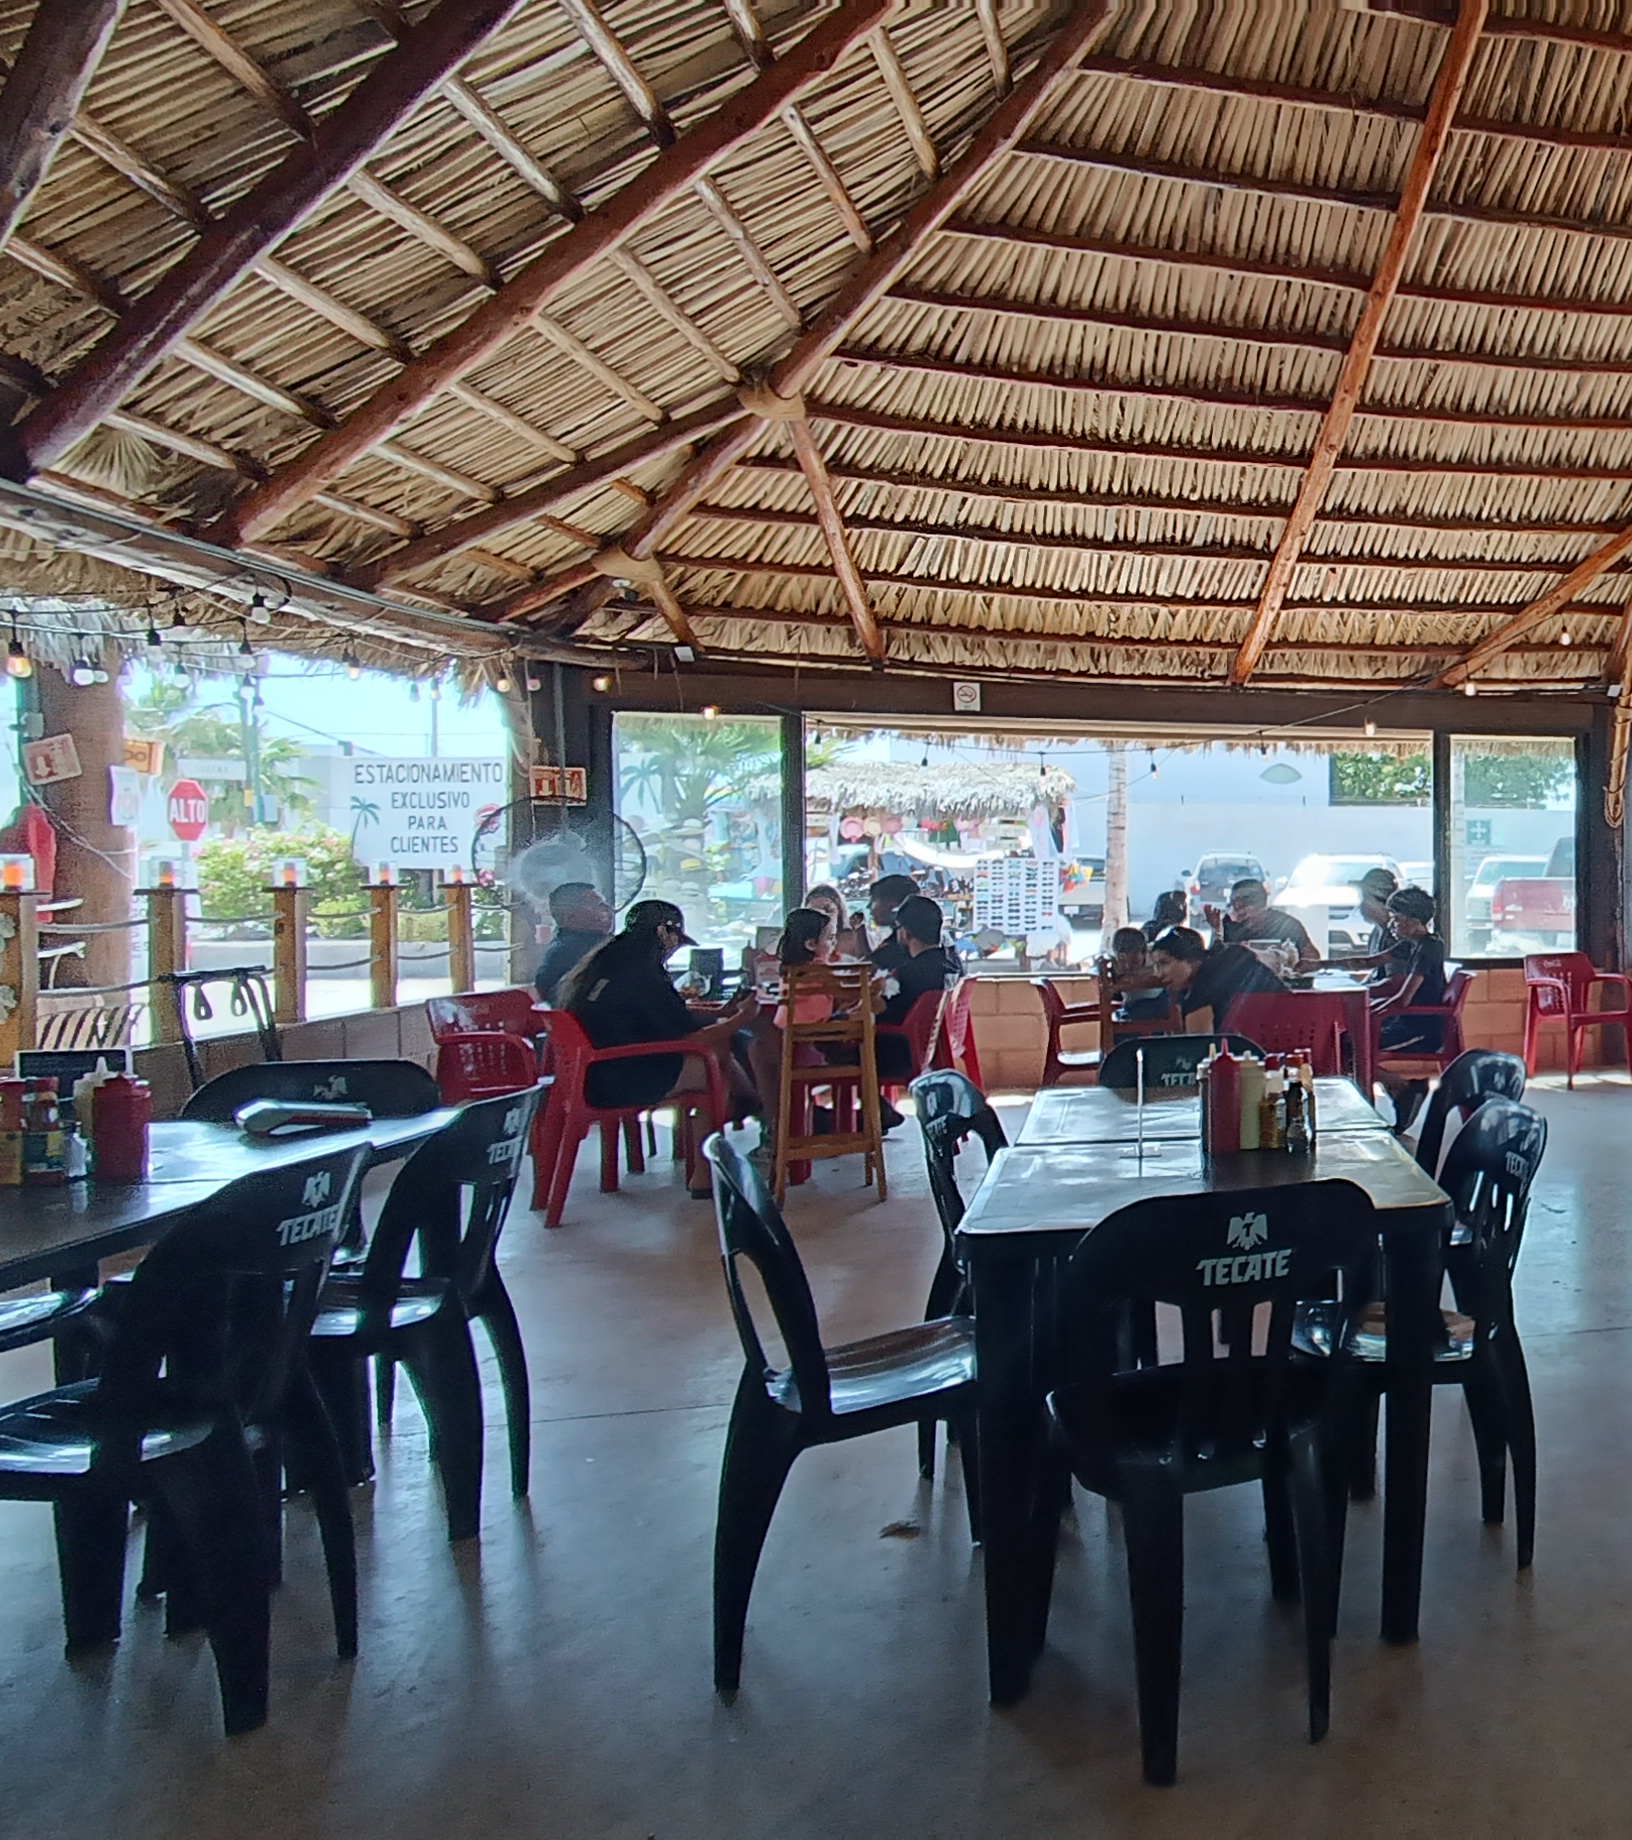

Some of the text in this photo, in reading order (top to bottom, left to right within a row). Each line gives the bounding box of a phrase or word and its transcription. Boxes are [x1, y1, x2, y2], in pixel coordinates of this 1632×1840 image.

[354, 763, 503, 784] ESTACIONAMIENTO
[391, 791, 470, 809] EXCLUSIVO
[169, 798, 207, 823] ALTO
[408, 815, 447, 830] PARA
[390, 836, 459, 853] CLIENTES
[1195, 1248, 1292, 1286] TECATE
